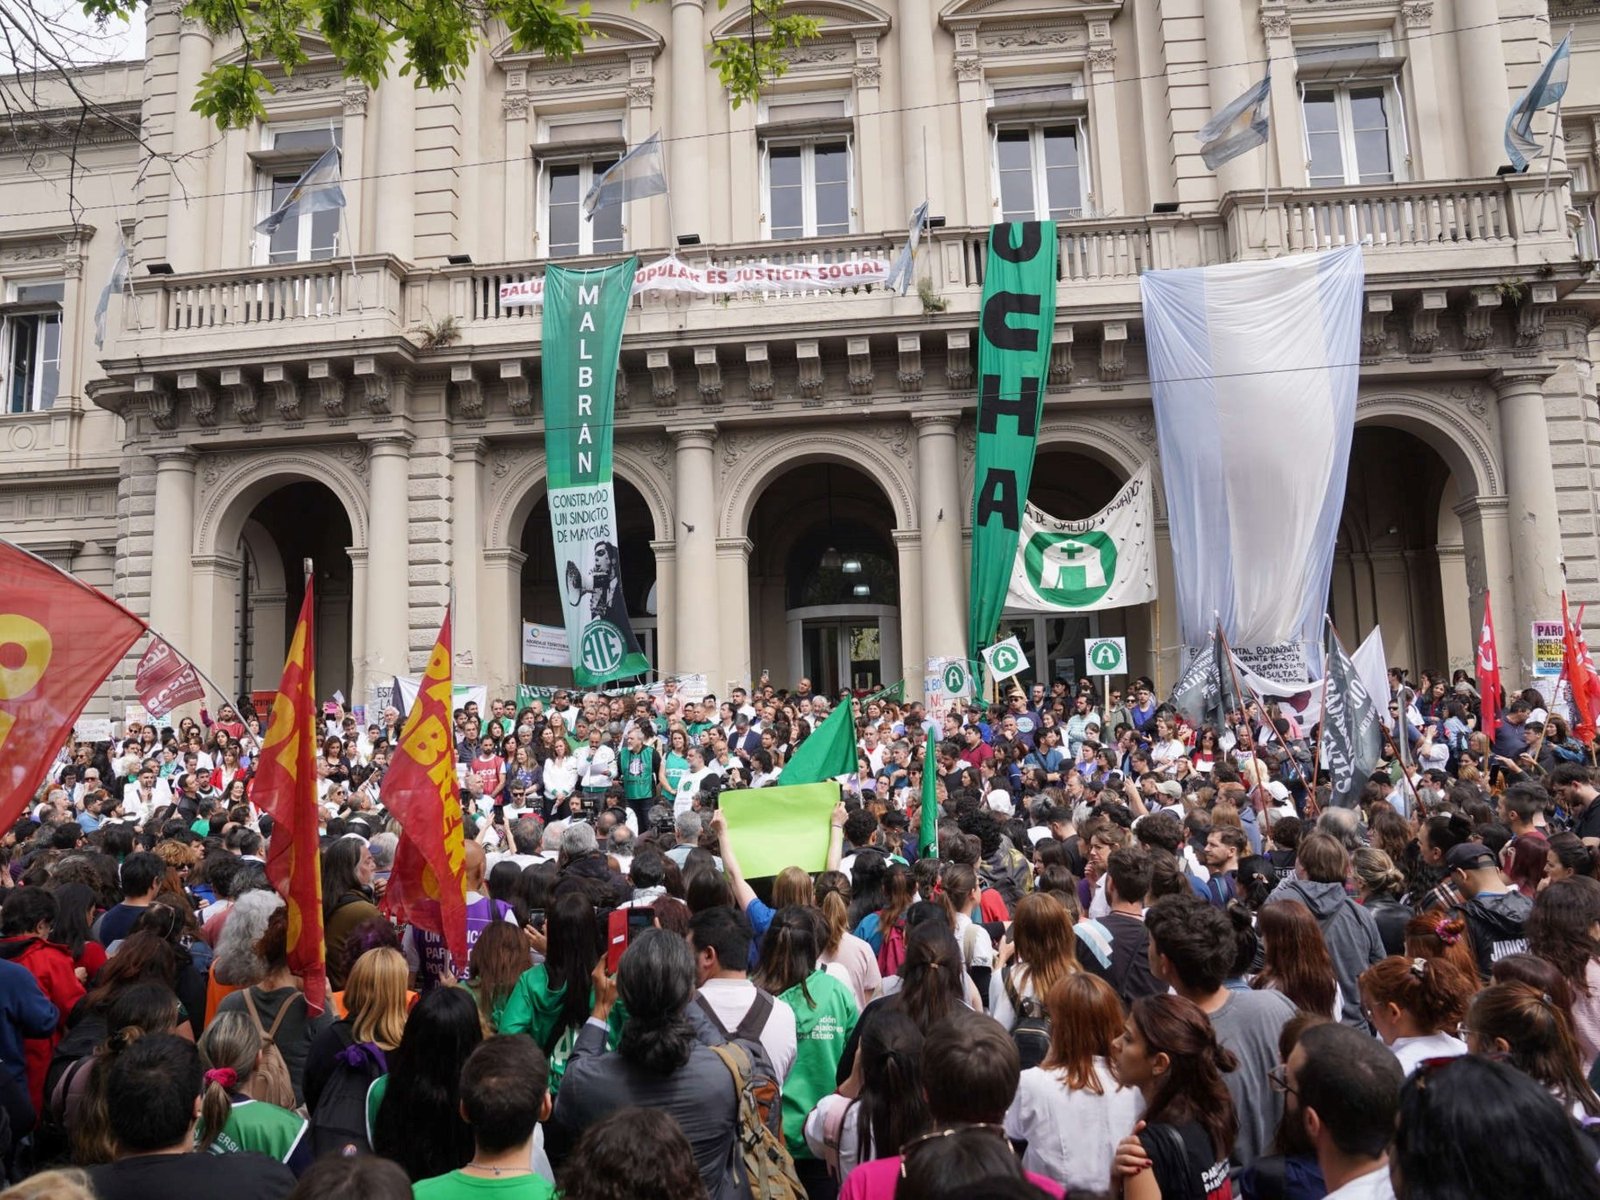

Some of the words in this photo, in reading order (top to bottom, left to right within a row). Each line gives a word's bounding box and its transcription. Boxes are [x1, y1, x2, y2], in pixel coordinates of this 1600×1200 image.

[500, 282, 544, 298] SALU
[635, 264, 700, 283] OPULAR
[706, 270, 727, 284] ES
[735, 268, 811, 283] JUSTICIA
[818, 261, 884, 280] SOCIAL
[1054, 519, 1096, 532] SALUD
[557, 530, 568, 543] DE
[1537, 625, 1563, 636] PARO
[583, 627, 620, 670] ATE
